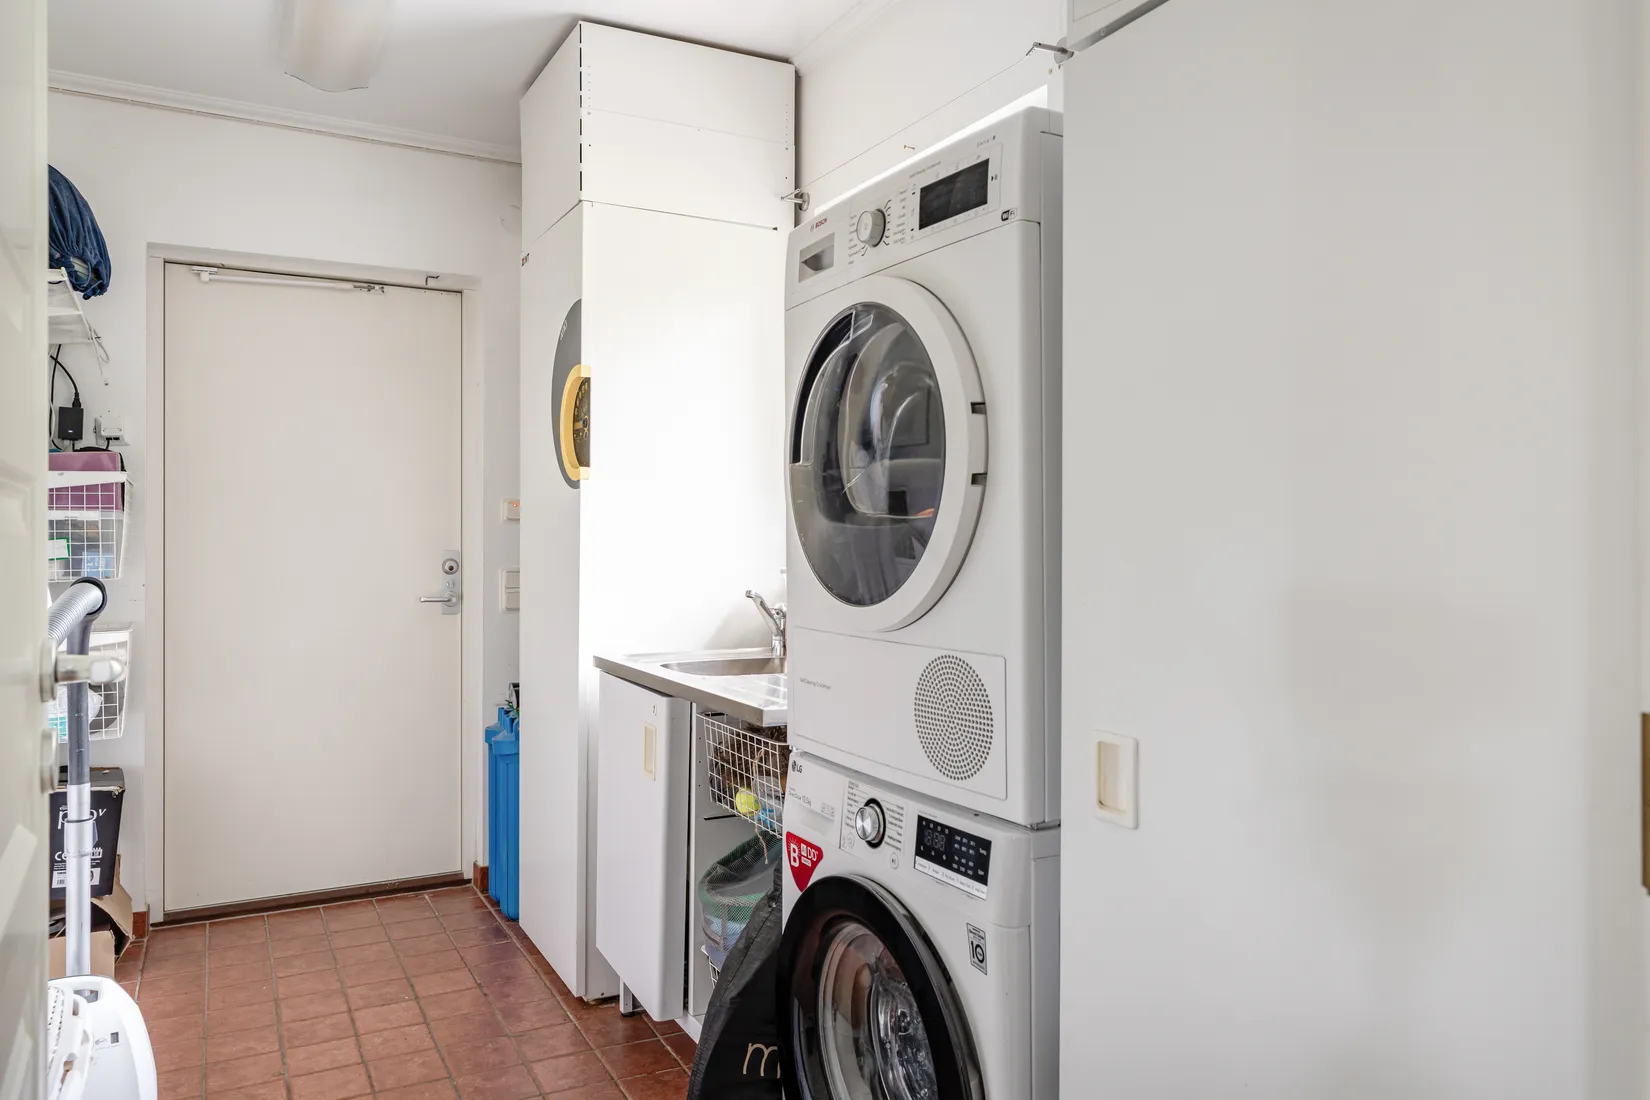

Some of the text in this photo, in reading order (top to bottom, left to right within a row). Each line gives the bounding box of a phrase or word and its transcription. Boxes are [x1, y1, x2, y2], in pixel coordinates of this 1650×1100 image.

[796, 763, 803, 774] LG
[790, 842, 800, 868] B
[970, 940, 985, 964] 10
